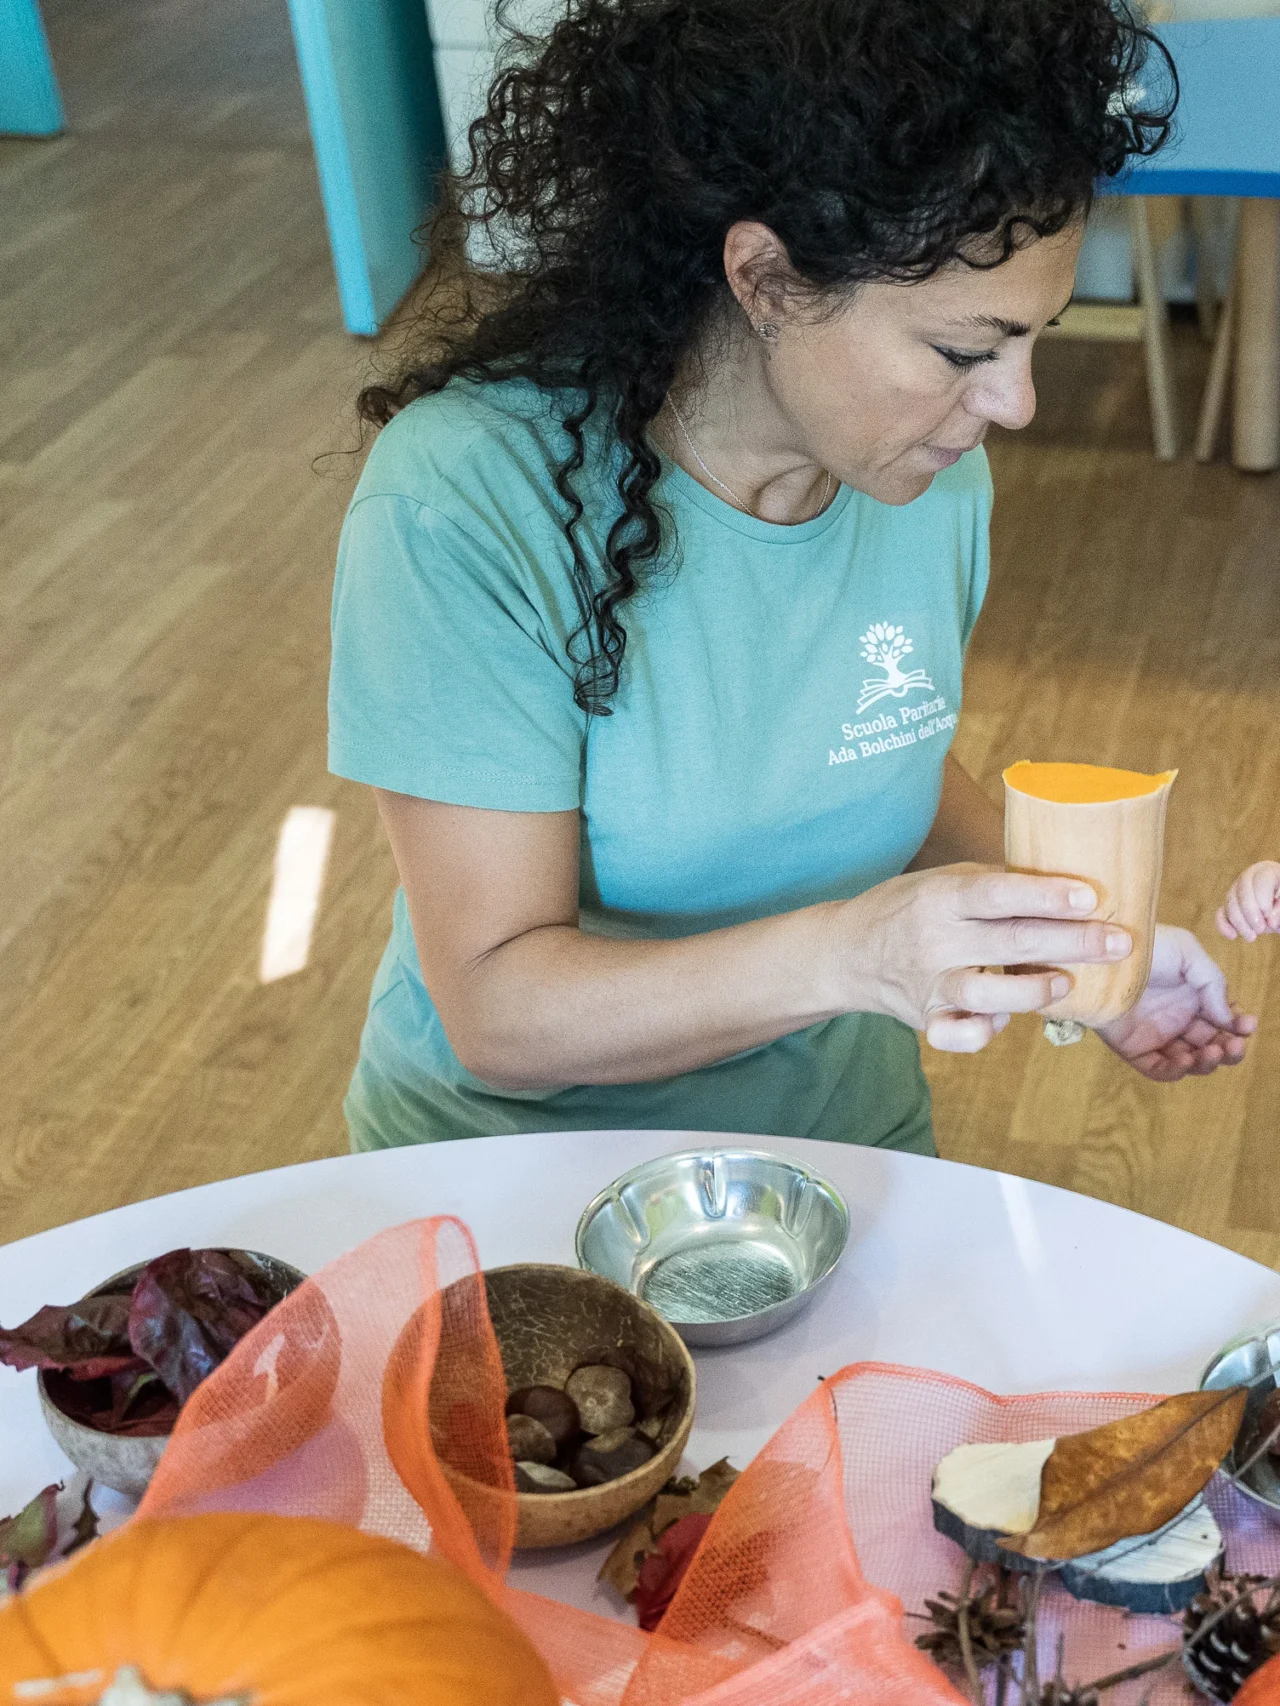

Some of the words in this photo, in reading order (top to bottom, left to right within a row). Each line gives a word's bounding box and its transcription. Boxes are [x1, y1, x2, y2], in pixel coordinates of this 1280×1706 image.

[841, 713, 898, 741] Scuola
[828, 747, 858, 766] Ada
[859, 728, 917, 757] Bolchini
